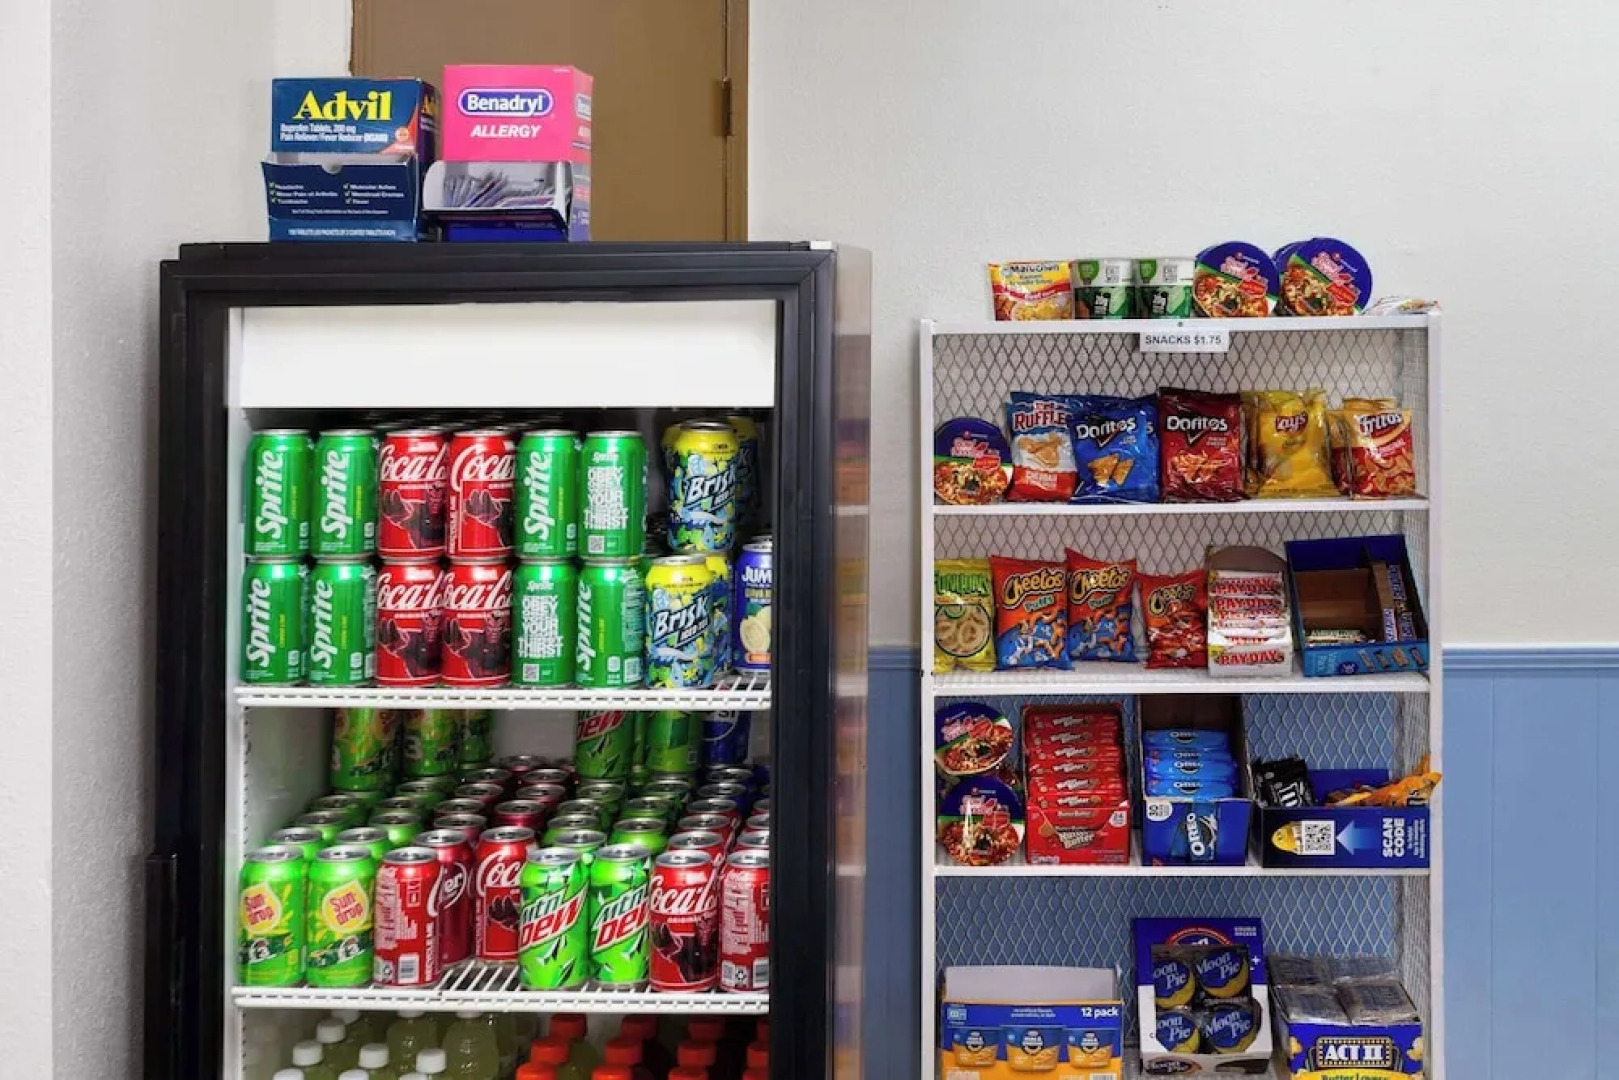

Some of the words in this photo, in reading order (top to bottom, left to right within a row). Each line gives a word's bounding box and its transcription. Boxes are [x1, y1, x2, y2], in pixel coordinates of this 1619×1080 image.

[292, 90, 392, 121] Advil
[467, 93, 543, 116] Benadryl
[470, 124, 541, 138] ALLERGY
[1145, 334, 1191, 345] SNACKS
[1194, 334, 1222, 346] $1.75
[1075, 416, 1136, 440] Doritos
[1166, 415, 1228, 431] Doritos
[255, 450, 288, 540] Sprite
[320, 450, 354, 539] Sprite
[523, 451, 555, 541] Sprite
[741, 564, 772, 585] JUM
[1071, 566, 1130, 606] Cheetos
[1003, 567, 1064, 608] Cheetos
[246, 577, 276, 668] Sprite
[310, 579, 338, 669] Sprite
[576, 579, 597, 672] Sprite
[653, 595, 709, 641] Brisk
[518, 635, 564, 659] THIRST
[1186, 812, 1205, 856] OREO
[1382, 817, 1393, 858] SCAN
[1393, 817, 1405, 858] CODE
[329, 891, 357, 910] Sun
[1153, 961, 1178, 979] oon
[1166, 973, 1187, 990] Pie
[1219, 961, 1240, 979] Pie
[1080, 1007, 1092, 1018] 12
[1094, 1006, 1119, 1019] pack
[1158, 1016, 1183, 1029] oon
[1205, 1011, 1240, 1038] Moon
[1170, 1025, 1191, 1042] Pie
[1231, 1019, 1252, 1039] Pie
[1325, 1044, 1359, 1061] ACT
[1362, 1044, 1384, 1061] II
